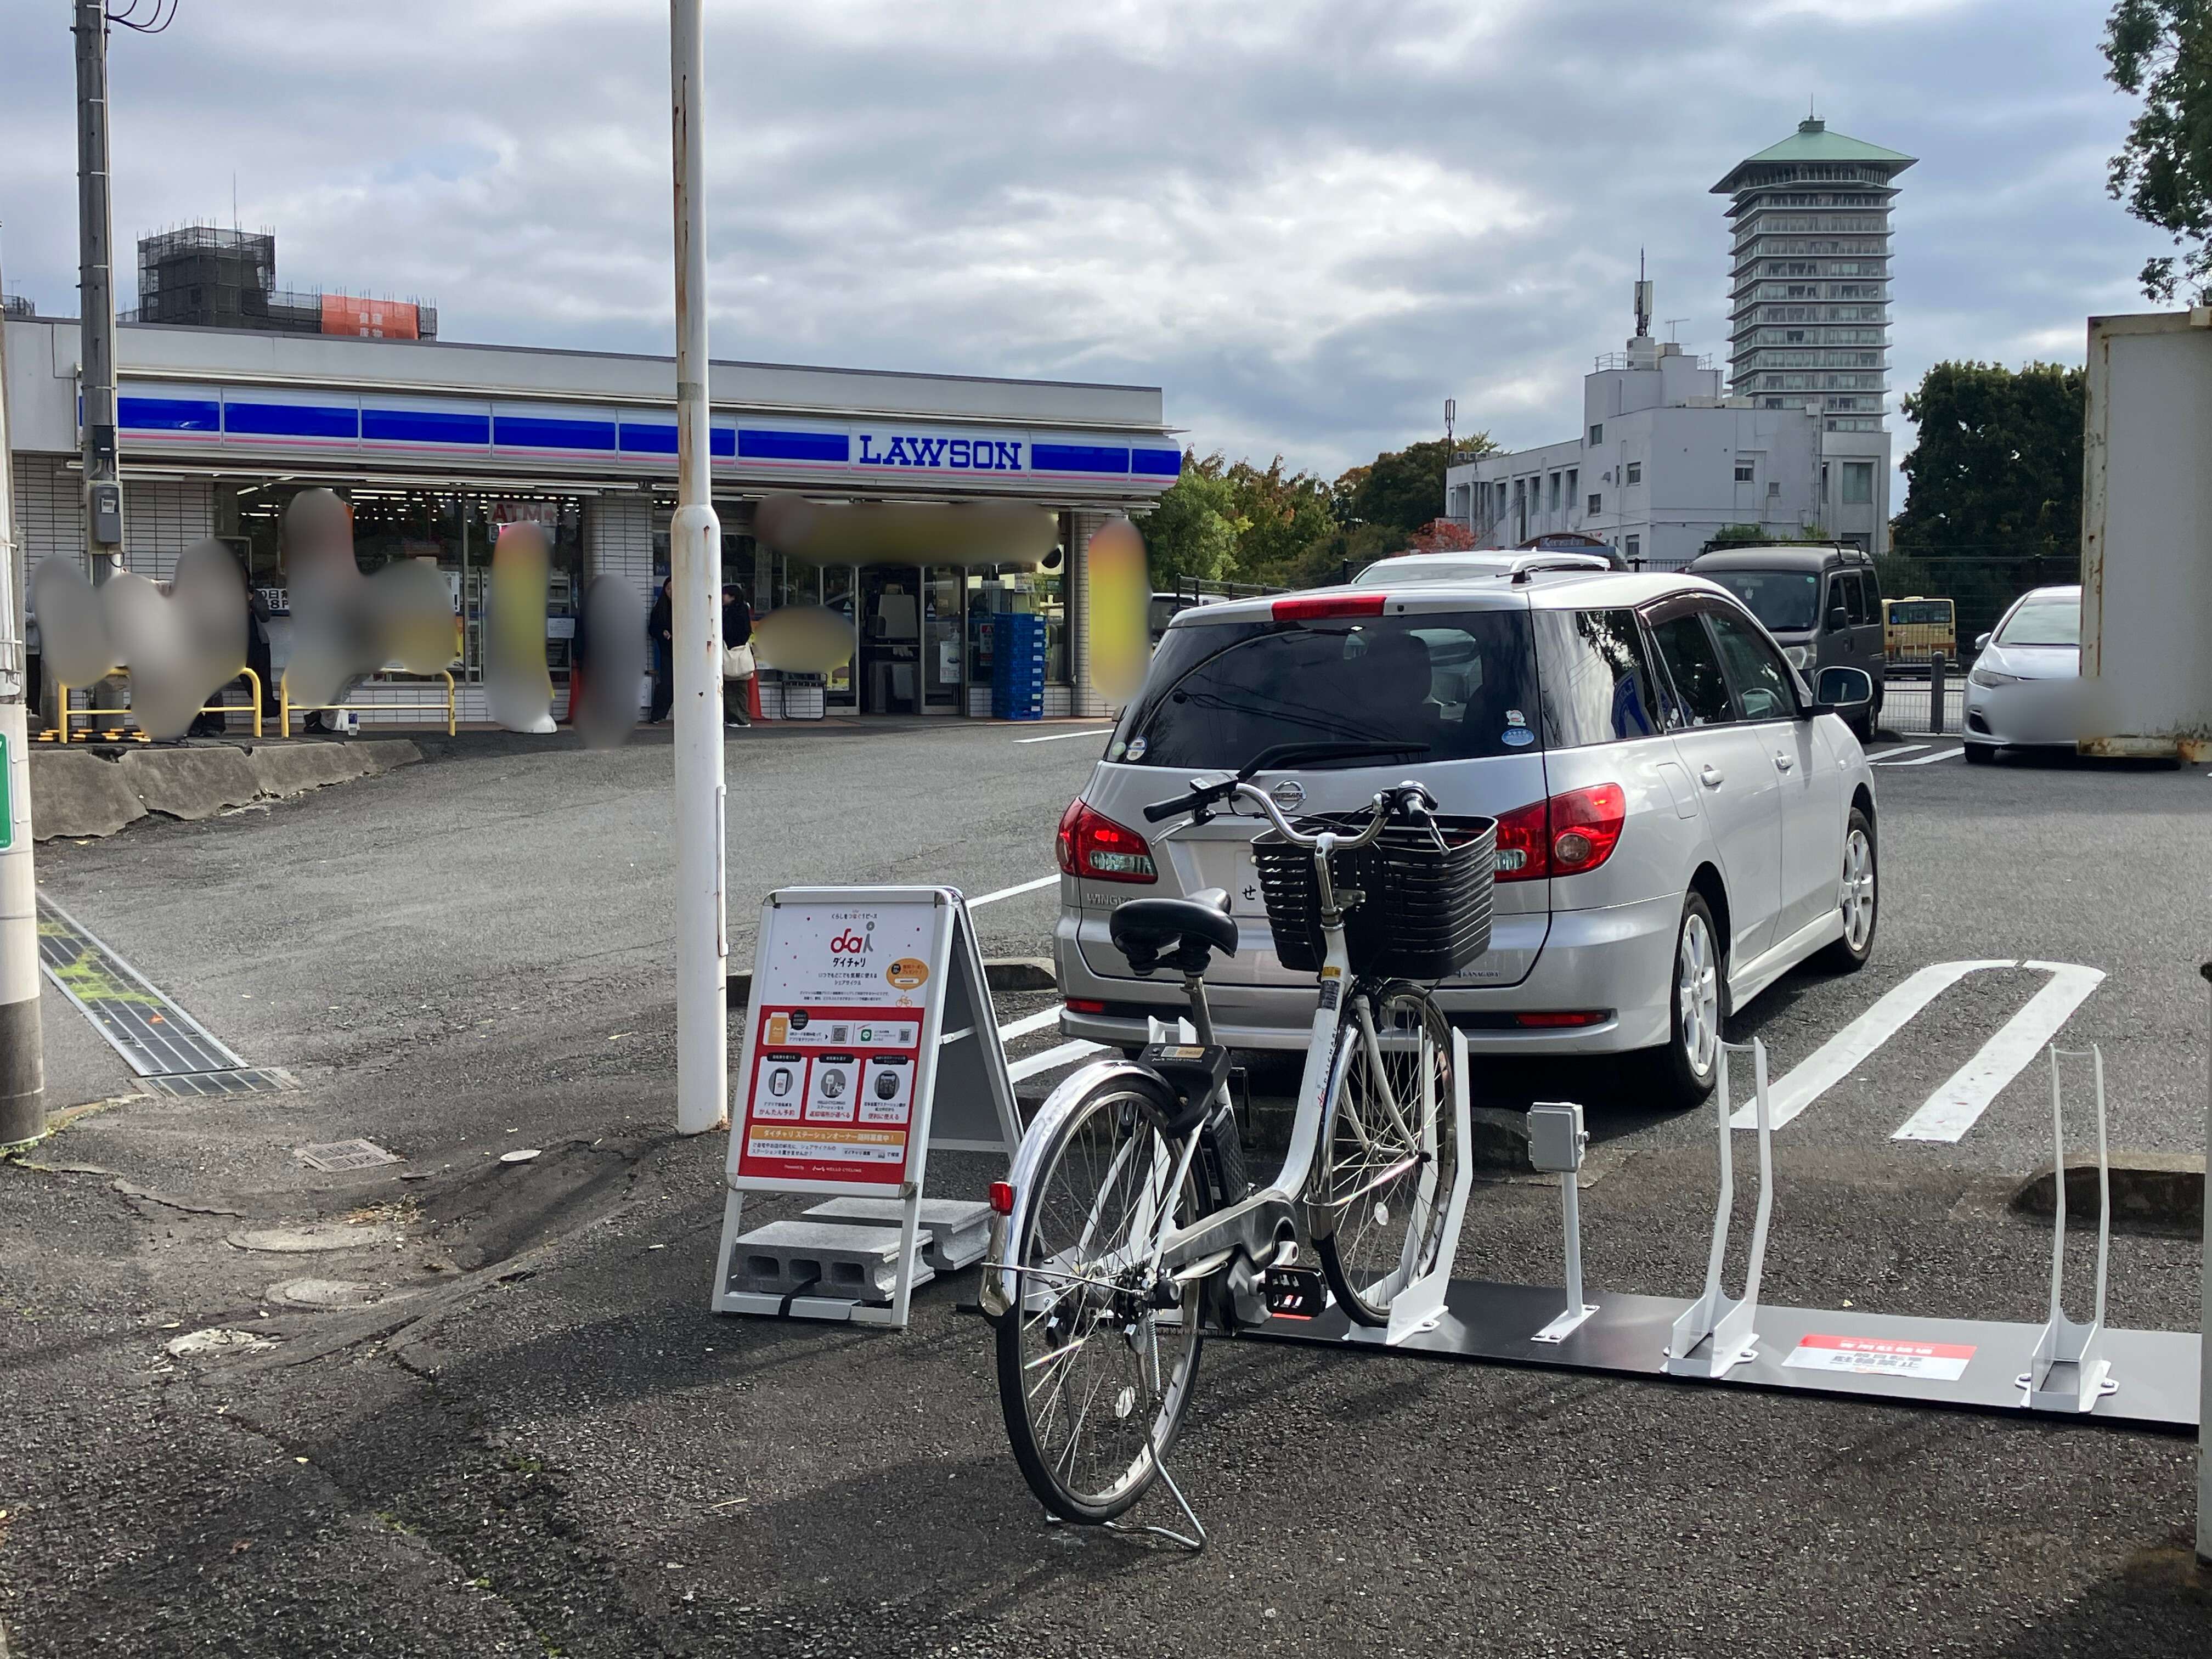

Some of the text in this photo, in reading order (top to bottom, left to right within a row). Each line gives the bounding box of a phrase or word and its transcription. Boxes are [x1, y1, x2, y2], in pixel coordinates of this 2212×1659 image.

[860, 435, 1022, 470] LAWSON
[492, 504, 541, 522] ATM
[833, 957, 866, 968] ダイチャリ
